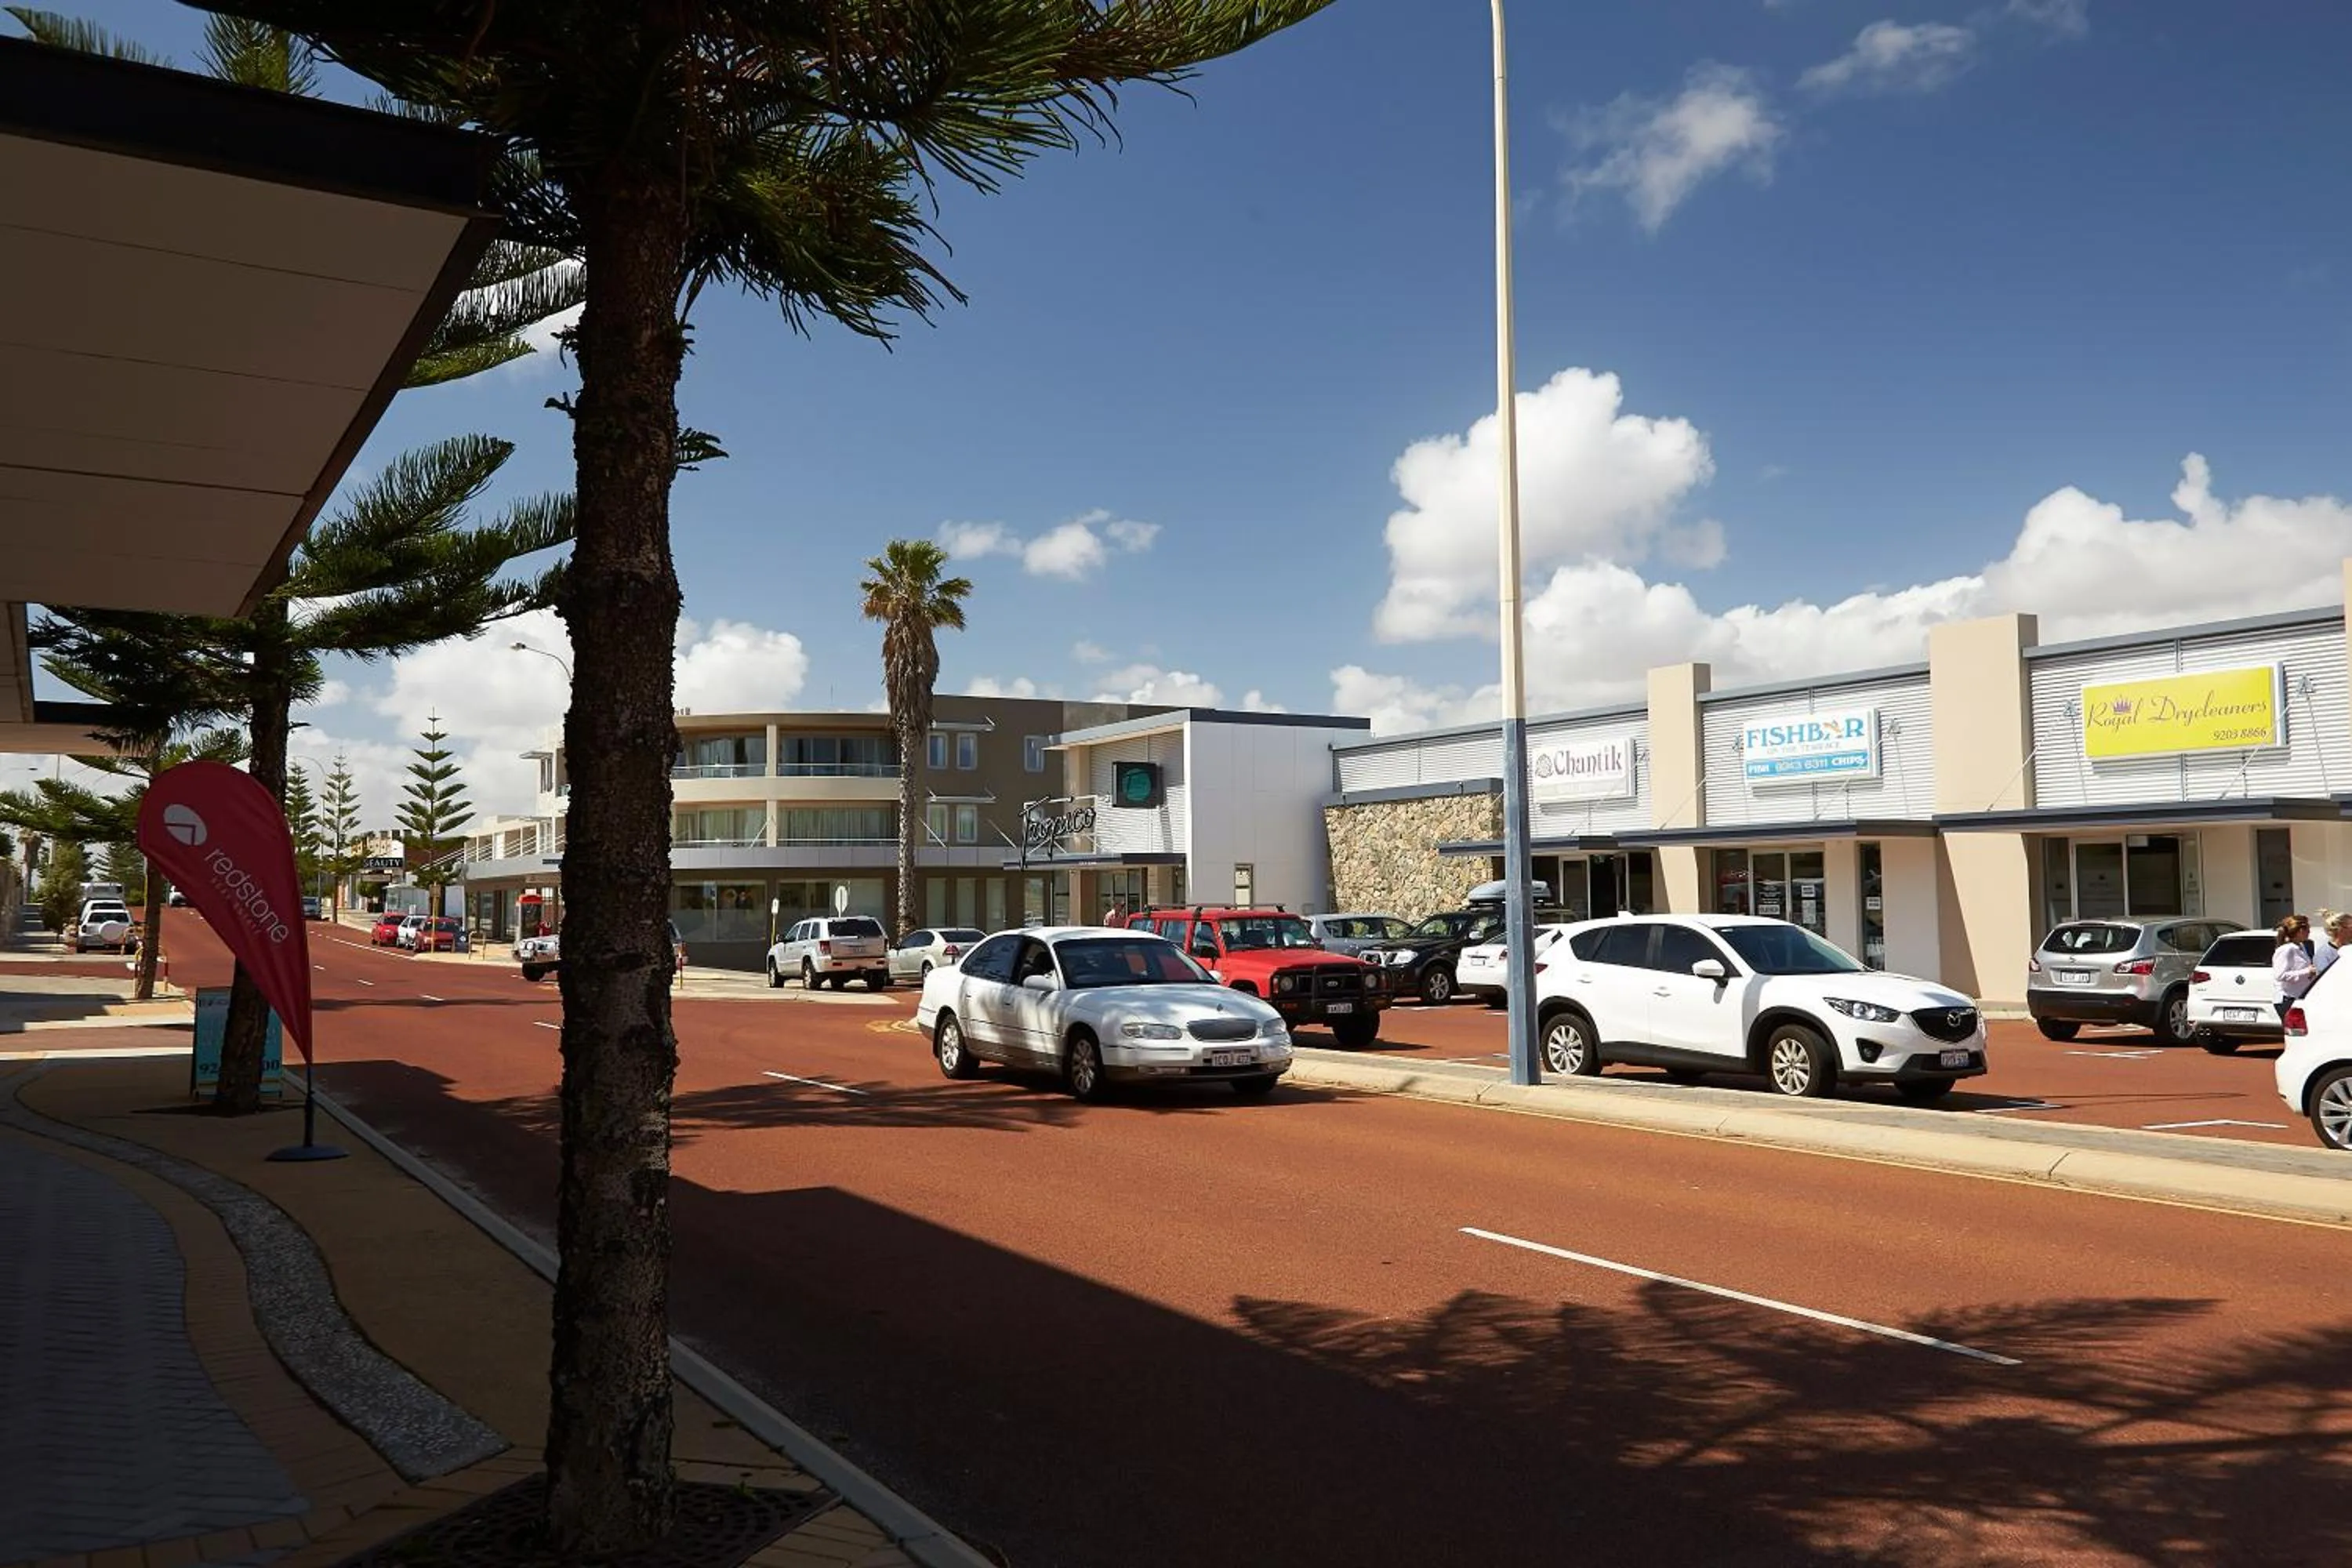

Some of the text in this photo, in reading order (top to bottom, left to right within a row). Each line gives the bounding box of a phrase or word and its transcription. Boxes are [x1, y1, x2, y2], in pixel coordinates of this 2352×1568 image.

[2087, 689, 2267, 732] Royal Drycleaners
[2212, 728, 2267, 741] 9203 8866
[1553, 745, 1623, 777] Chantik
[1831, 755, 1866, 768] CHIPS
[204, 848, 289, 943] redstone
